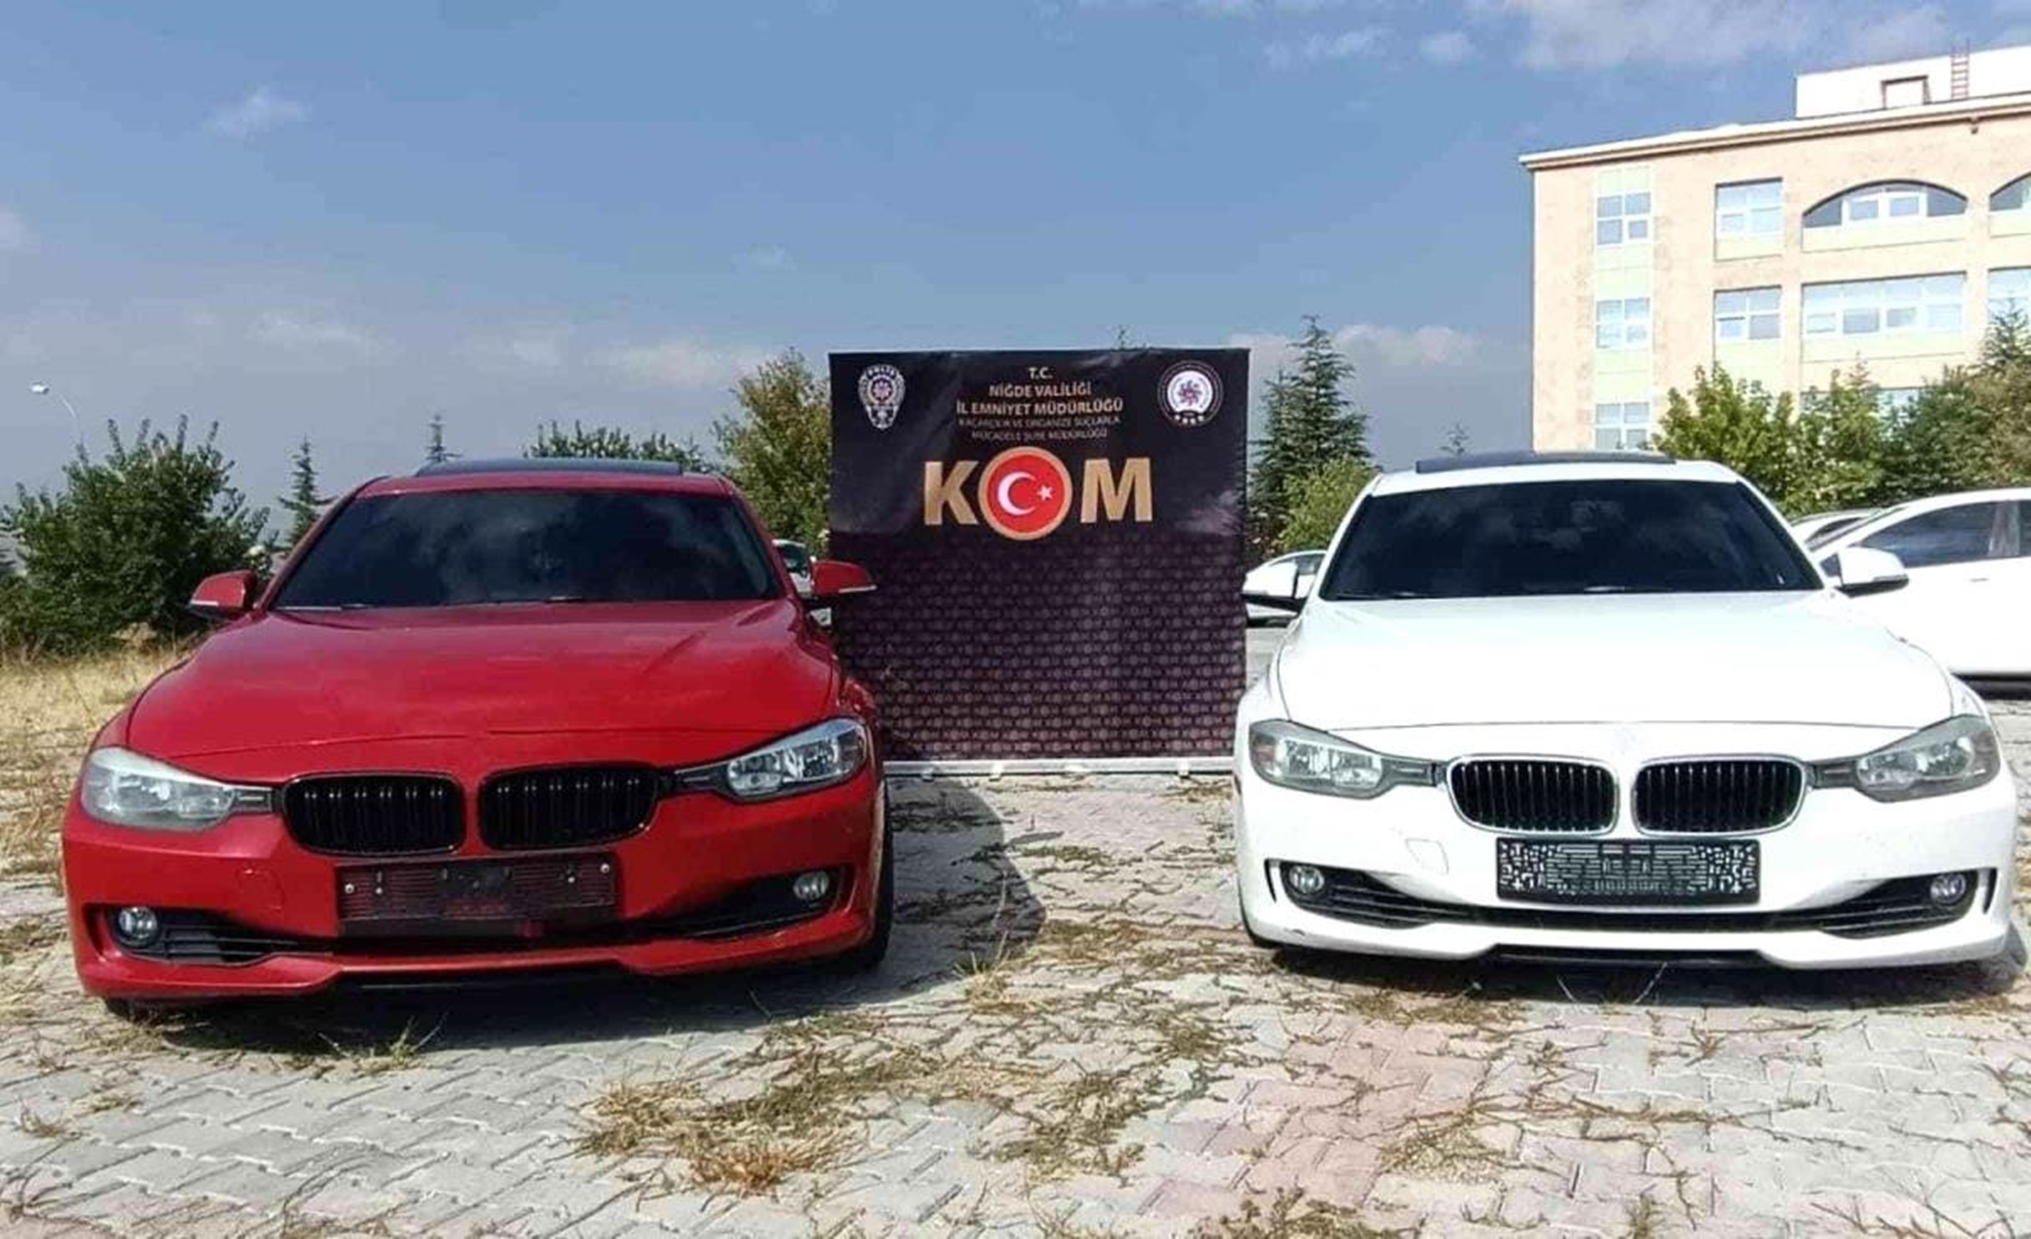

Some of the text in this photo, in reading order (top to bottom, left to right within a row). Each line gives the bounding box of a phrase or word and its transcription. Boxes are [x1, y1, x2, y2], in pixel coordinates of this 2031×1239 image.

[1028, 367, 1053, 379] T.C.
[989, 382, 1091, 397] NİĞDE VALİLİĞİ
[957, 397, 1124, 415] İL EMNİYET MÜDÜRLÜĞÜ
[924, 446, 1153, 540] KOM
